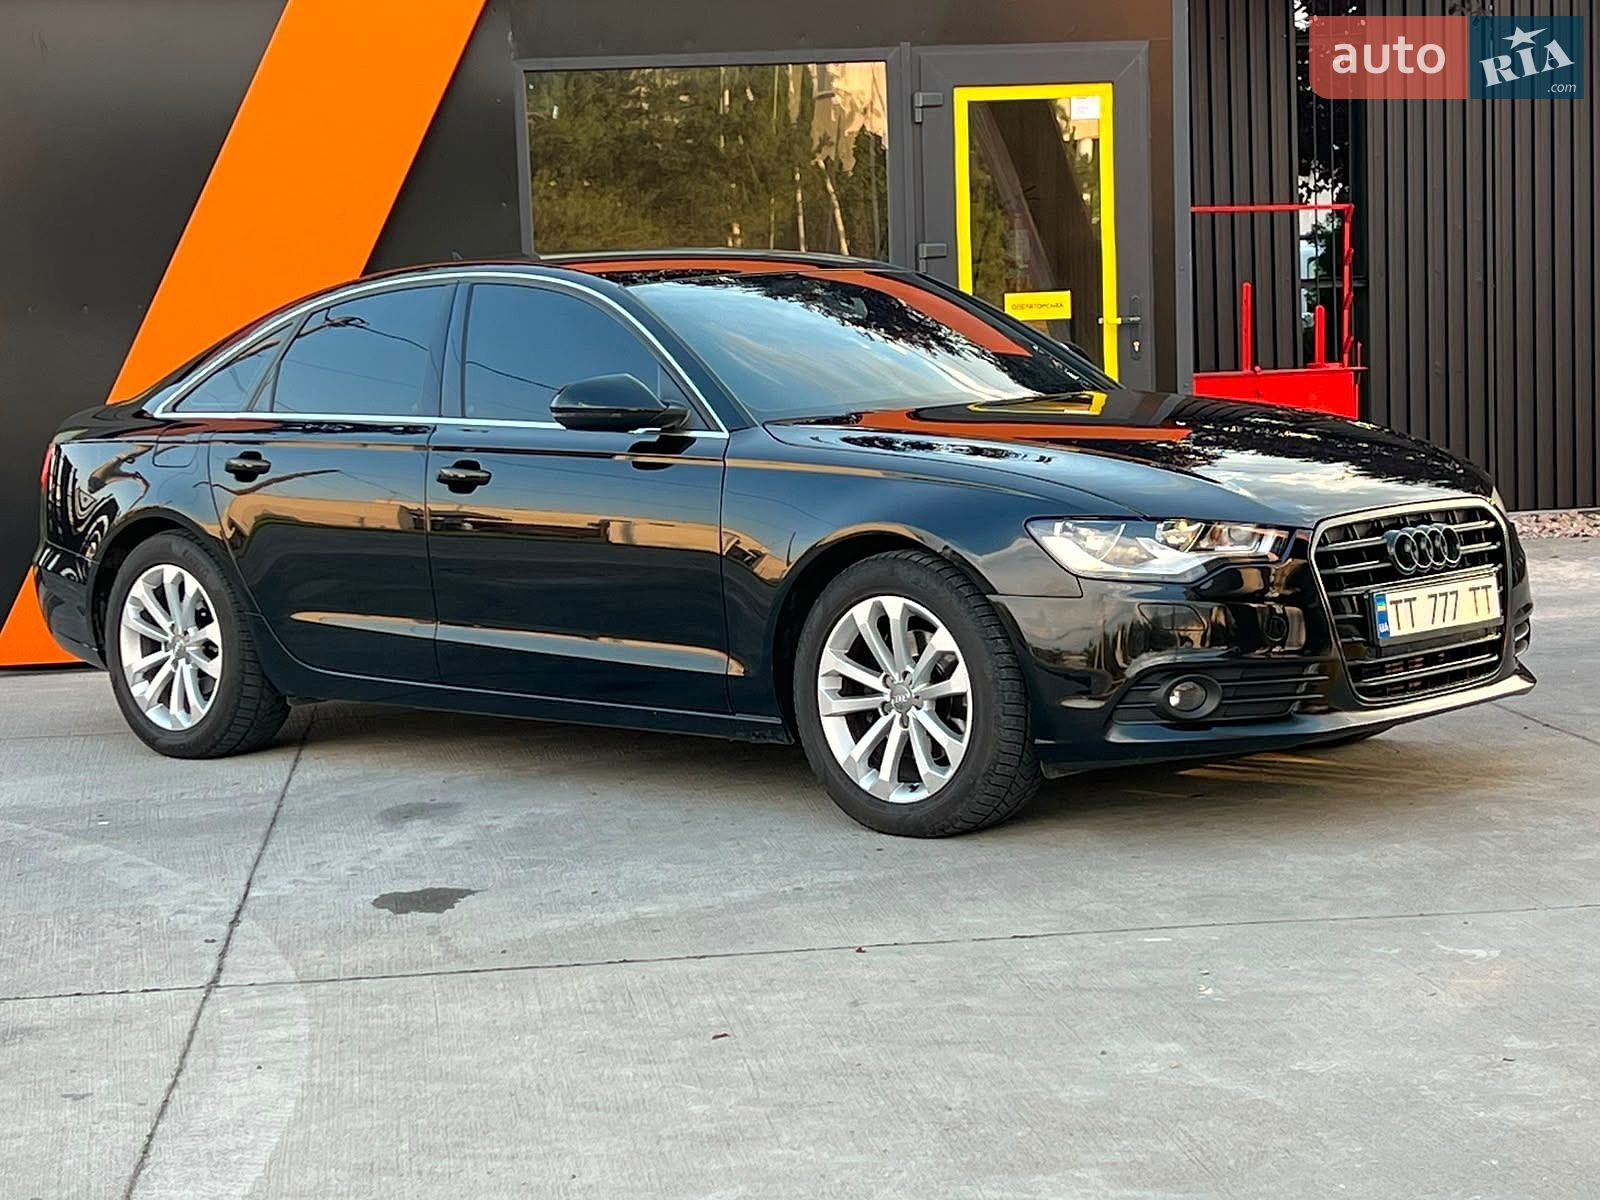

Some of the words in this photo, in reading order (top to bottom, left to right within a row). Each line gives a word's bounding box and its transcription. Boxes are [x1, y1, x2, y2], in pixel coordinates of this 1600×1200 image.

[1390, 597, 1417, 630] TT
[1428, 590, 1458, 625] 777
[1469, 585, 1492, 616] TT
